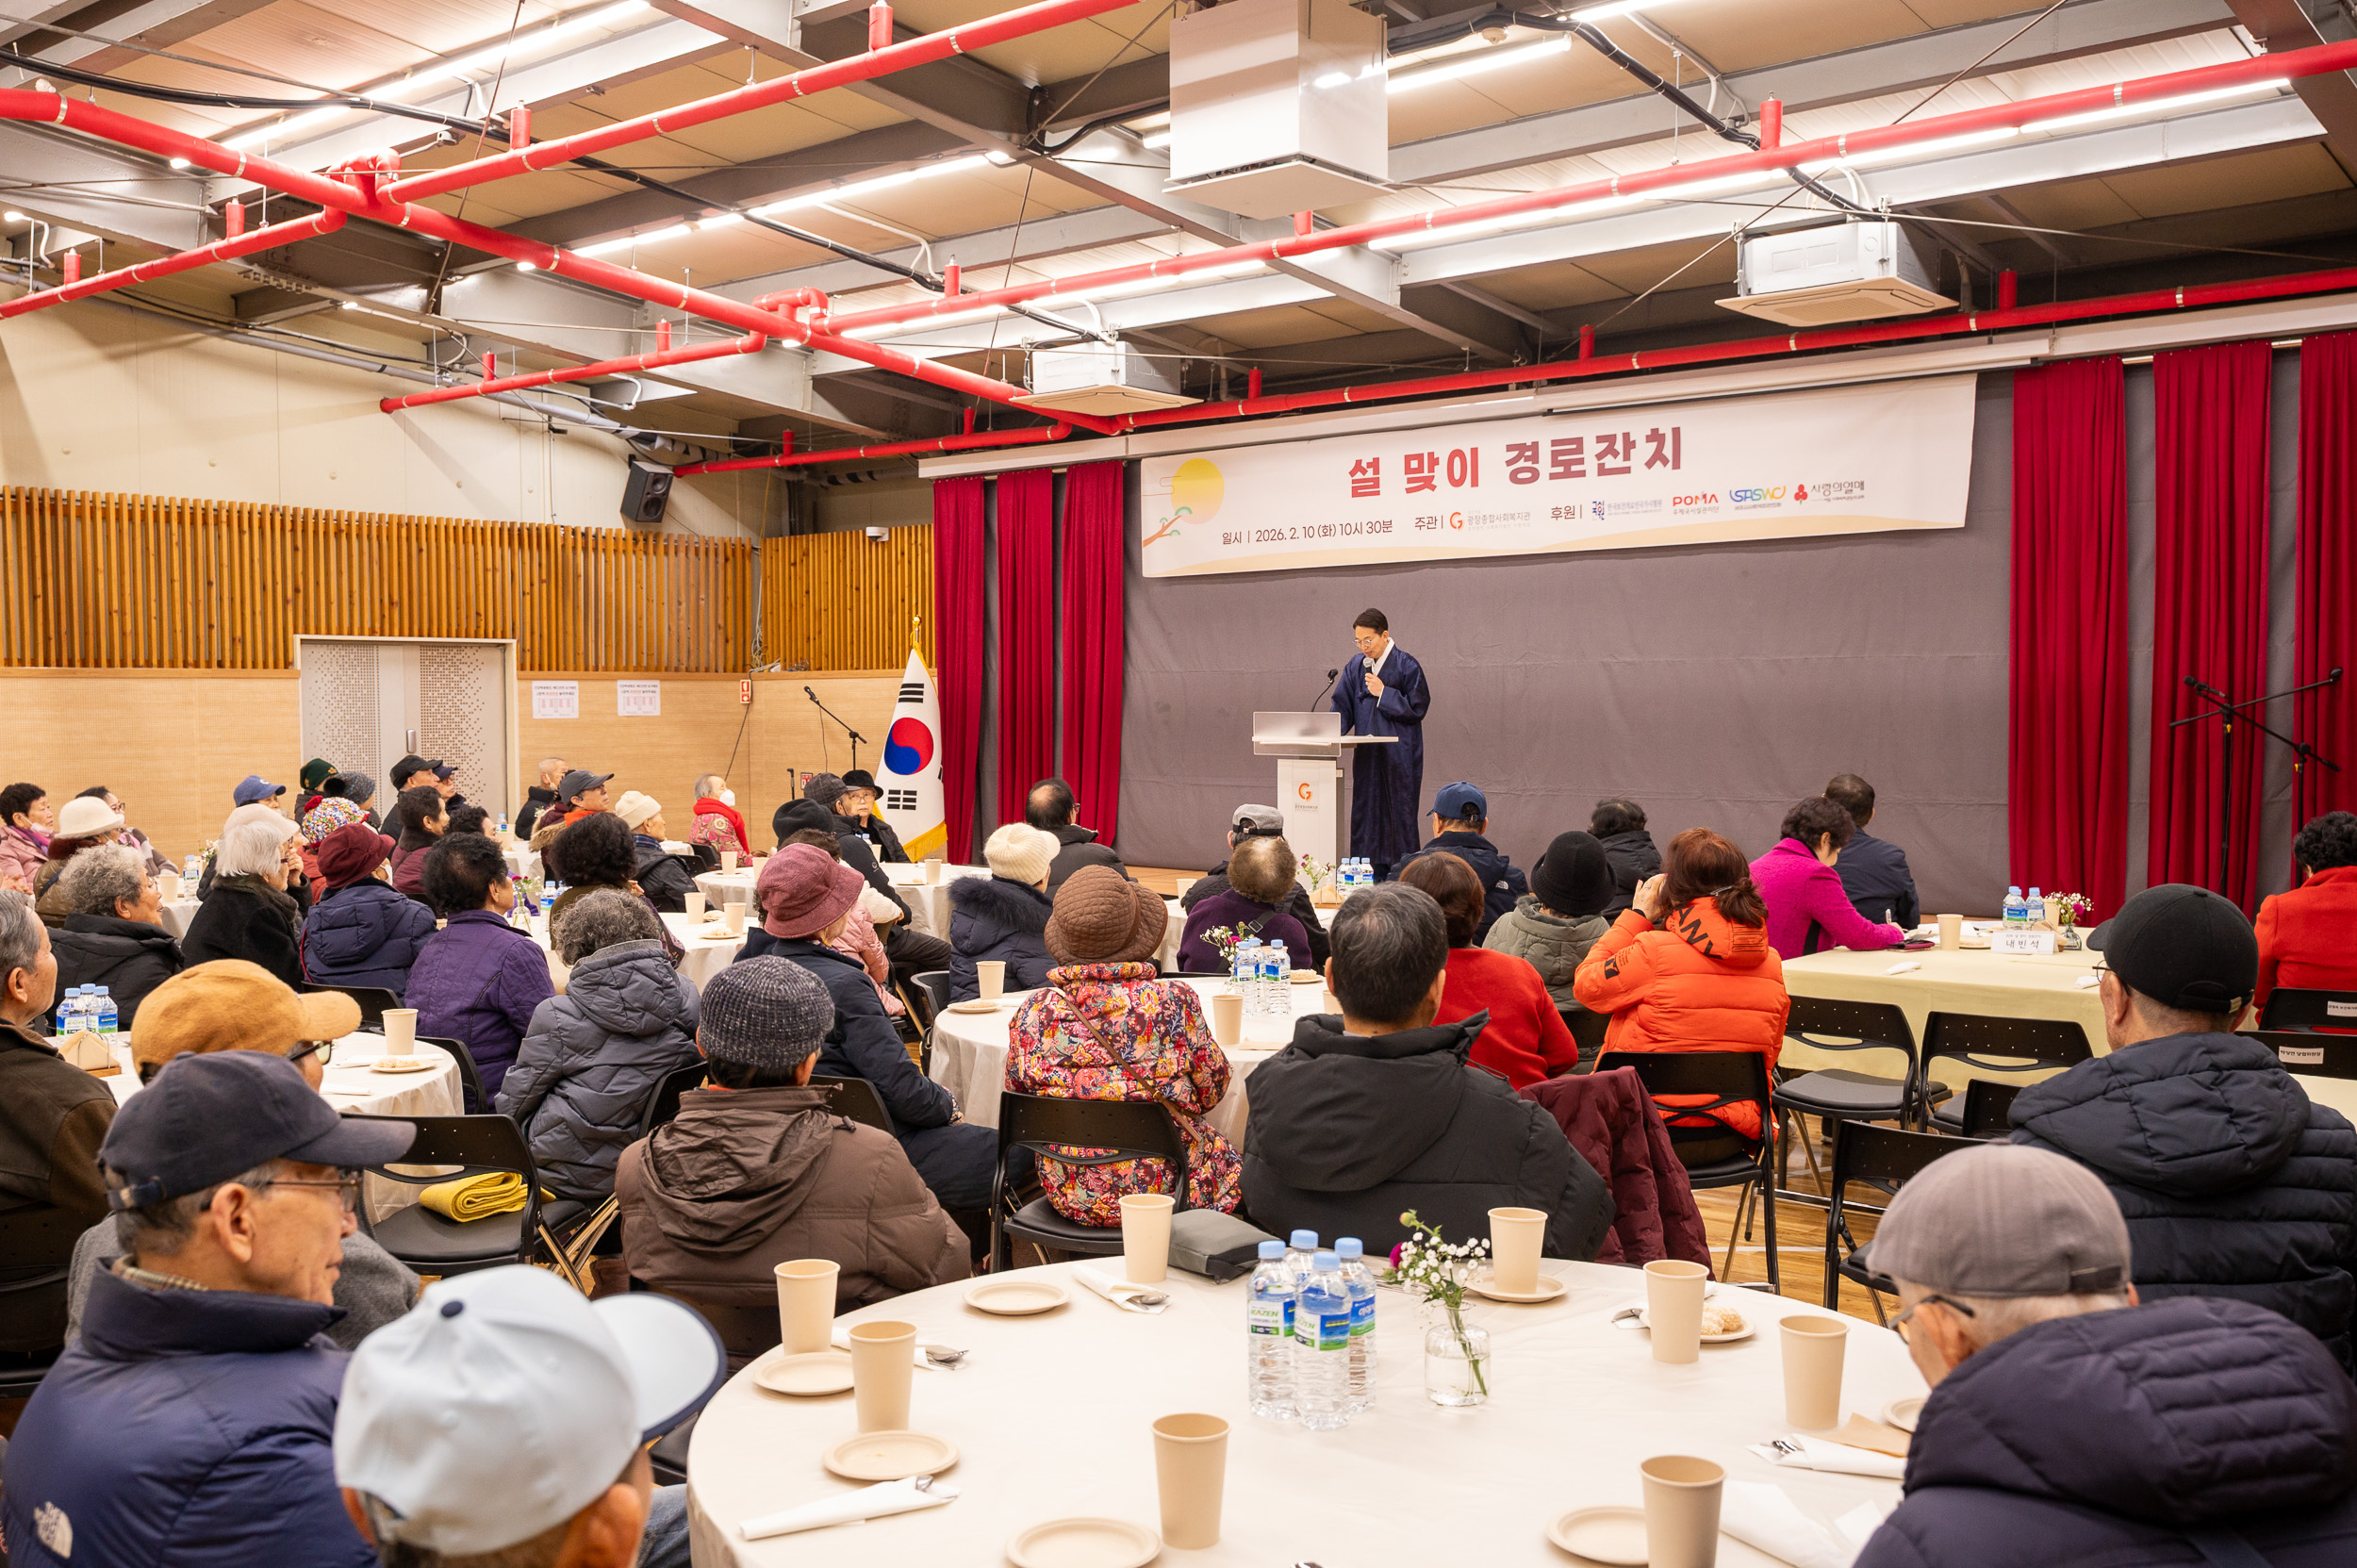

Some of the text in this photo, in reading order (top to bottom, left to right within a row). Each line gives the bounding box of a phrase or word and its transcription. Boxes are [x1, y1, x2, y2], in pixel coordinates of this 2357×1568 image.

[1348, 426, 1681, 498] 설 맞이 경로잔치
[1810, 480, 1865, 497] 사랑의열매
[1673, 493, 1719, 506] POMA
[1467, 511, 1531, 526] 광장종합사회복지관
[1550, 505, 1575, 520] 후원
[1414, 516, 1438, 531] 주관
[1222, 520, 1393, 545] 일시 2026. 2. 10 (화) 10시 30분
[1250, 1309, 1278, 1317] KAZEN
